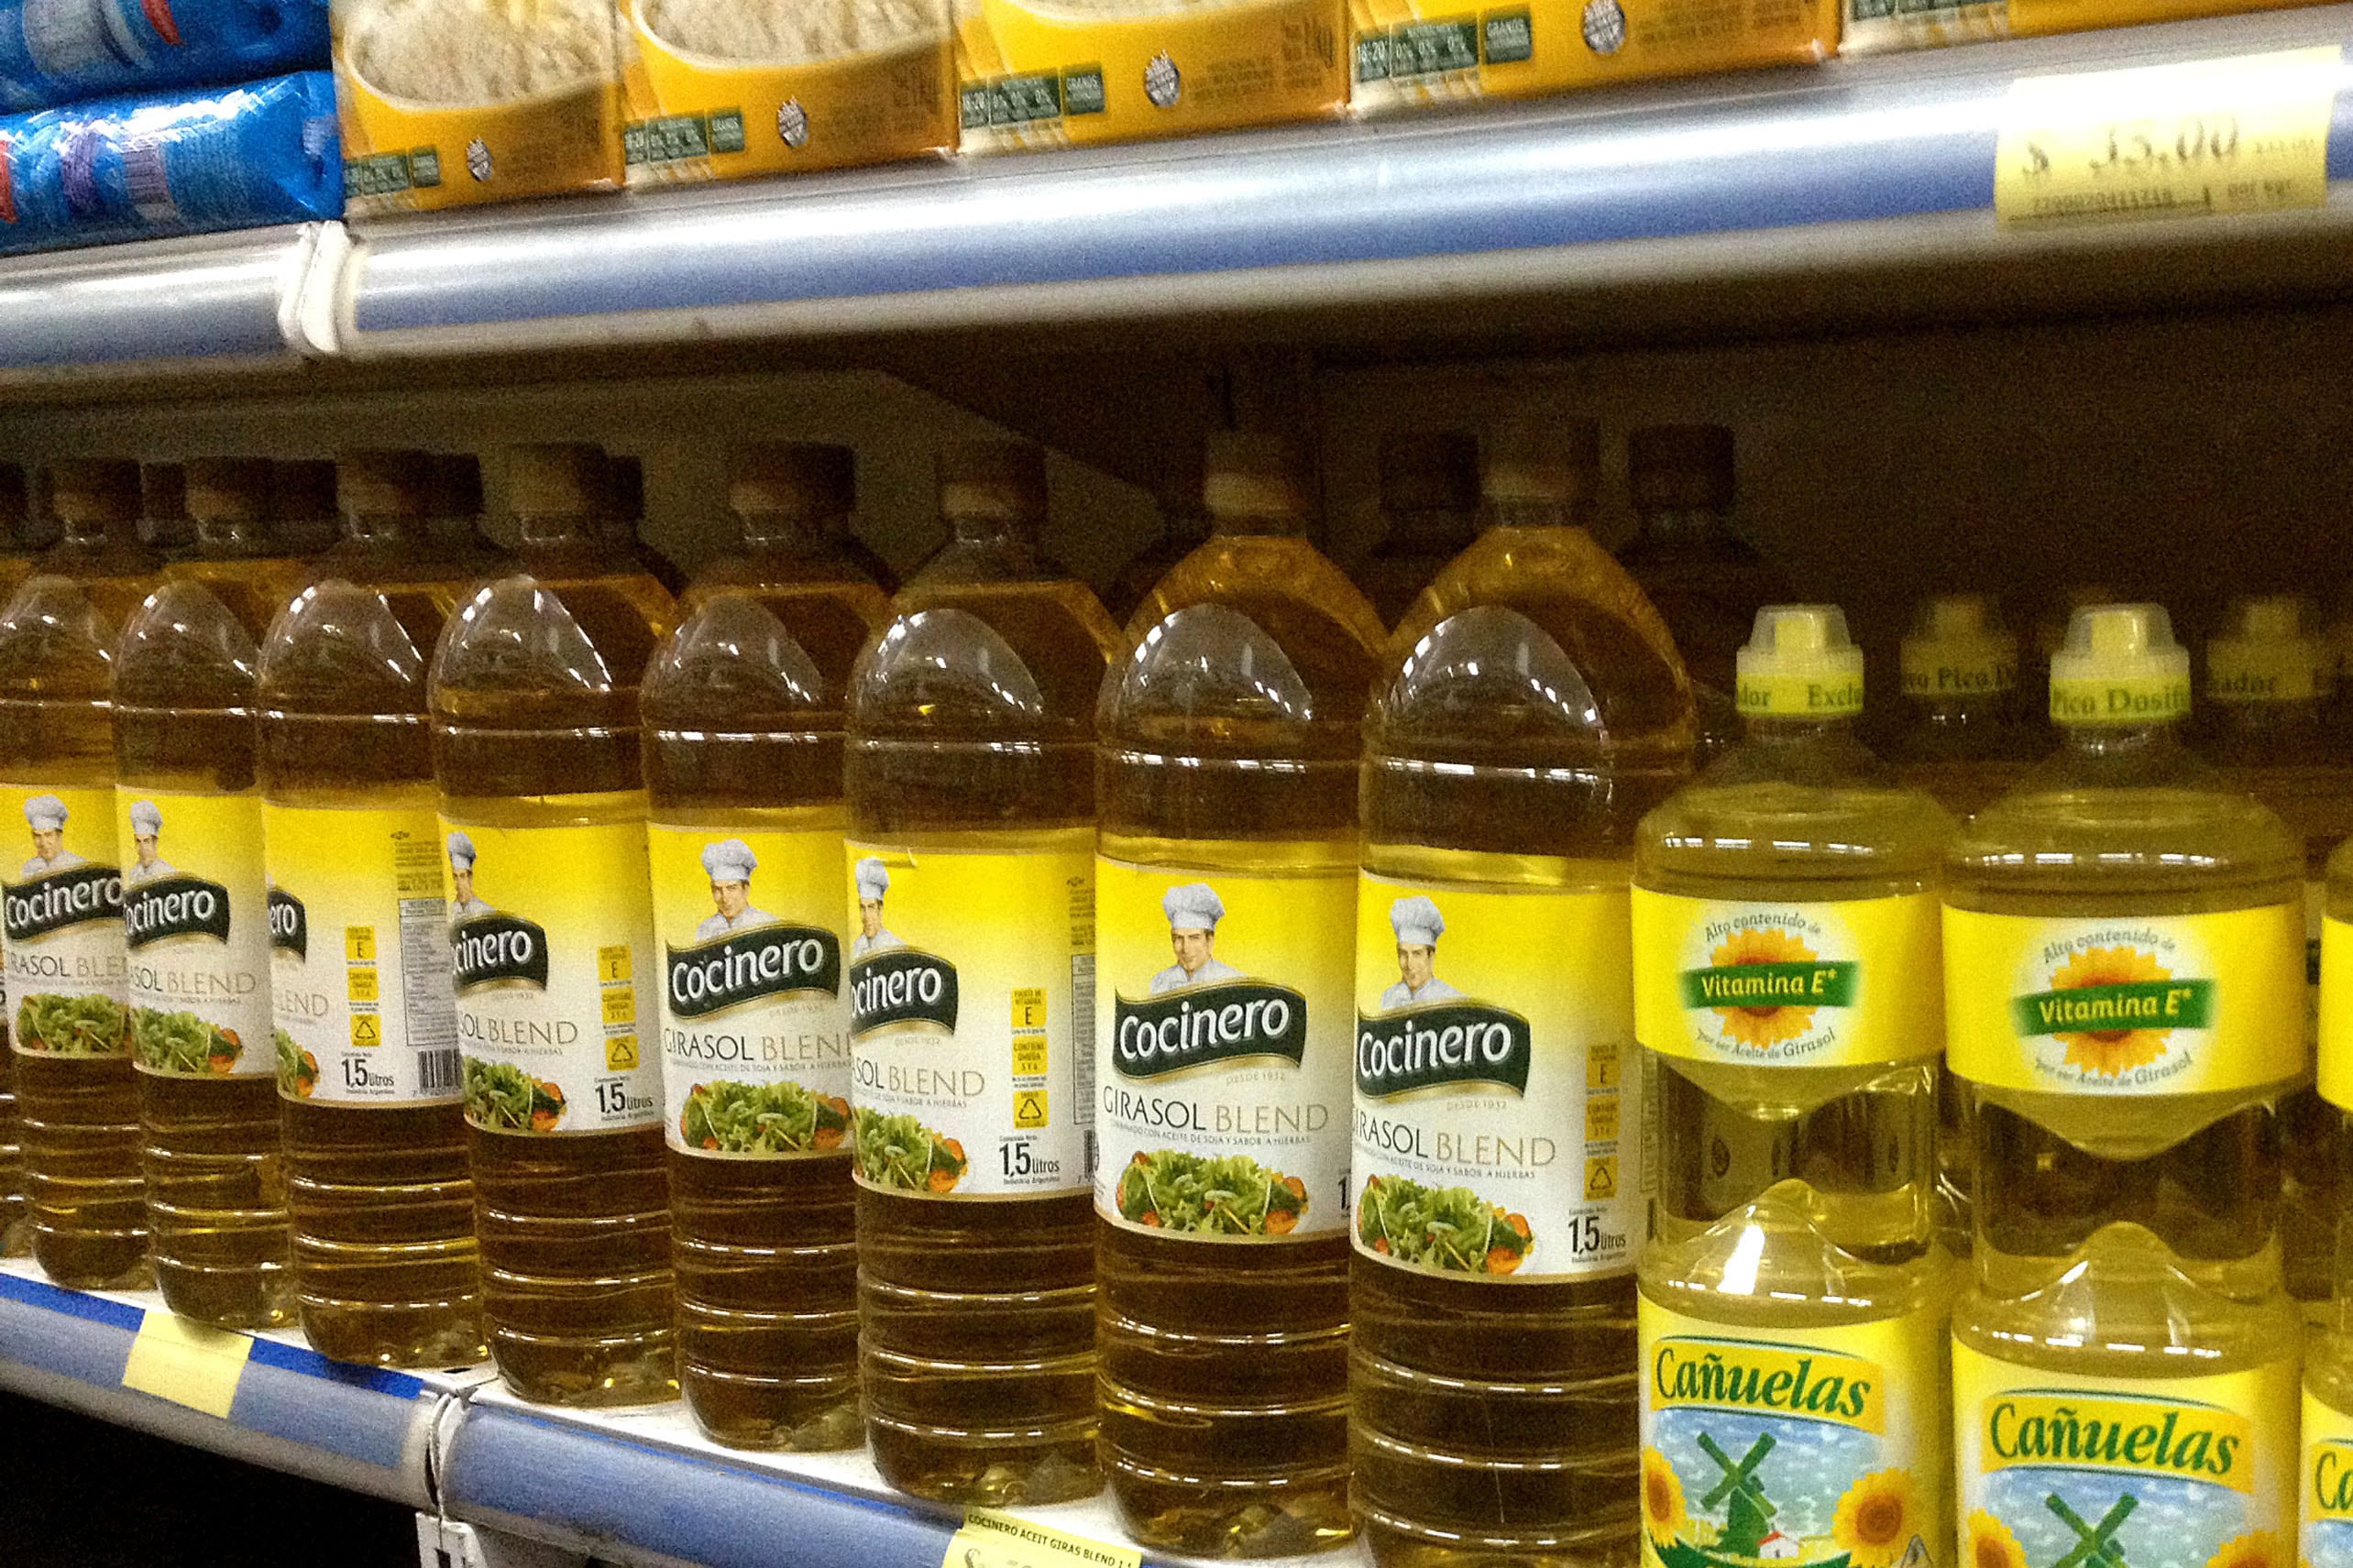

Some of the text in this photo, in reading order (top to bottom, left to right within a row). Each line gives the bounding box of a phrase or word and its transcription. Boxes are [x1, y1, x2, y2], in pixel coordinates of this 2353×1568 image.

[5, 876, 124, 929] Cocinero
[124, 890, 216, 935] ocinero
[1704, 911, 1821, 943] Alto contenido de
[451, 929, 533, 973] cinero
[2043, 938, 2074, 964] Alto
[2077, 927, 2159, 947] contenido
[167, 970, 258, 996] BLEND
[671, 938, 825, 1003] Cocinero
[1701, 974, 1806, 998] Vitamina
[277, 987, 330, 1018] LEND
[851, 967, 942, 1018] cinero
[2040, 994, 2159, 1025] Vitamina
[488, 1018, 578, 1045] BLEND
[1025, 1006, 1033, 1025] E
[1119, 998, 1292, 1060] Cocinero
[663, 1027, 755, 1061] GIRASOL
[1358, 1020, 1512, 1080] Cocinero
[1734, 1043, 1765, 1059] Aceite
[1783, 1025, 1836, 1058] Girasol
[340, 1058, 395, 1089] 1,5 litros
[888, 1065, 985, 1098] BLEND
[2134, 1049, 2194, 1085] Girasol
[1103, 1085, 1328, 1135] GIRASOL BLEND
[1232, 1135, 1263, 1146] SABOR
[1352, 1107, 1556, 1168] IRASOL BLEND
[998, 1142, 1060, 1178] 1,5 litros
[1568, 1215, 1626, 1255] 1,5 litros
[1655, 1347, 1872, 1418] Cañuelas
[1989, 1402, 2240, 1475] Cañuelas
[967, 1513, 1018, 1537] COCINERO
[1019, 1530, 1049, 1546] ACEIT
[1050, 1538, 1081, 1556] GIRAS
[1083, 1548, 1116, 1566] BLEND
